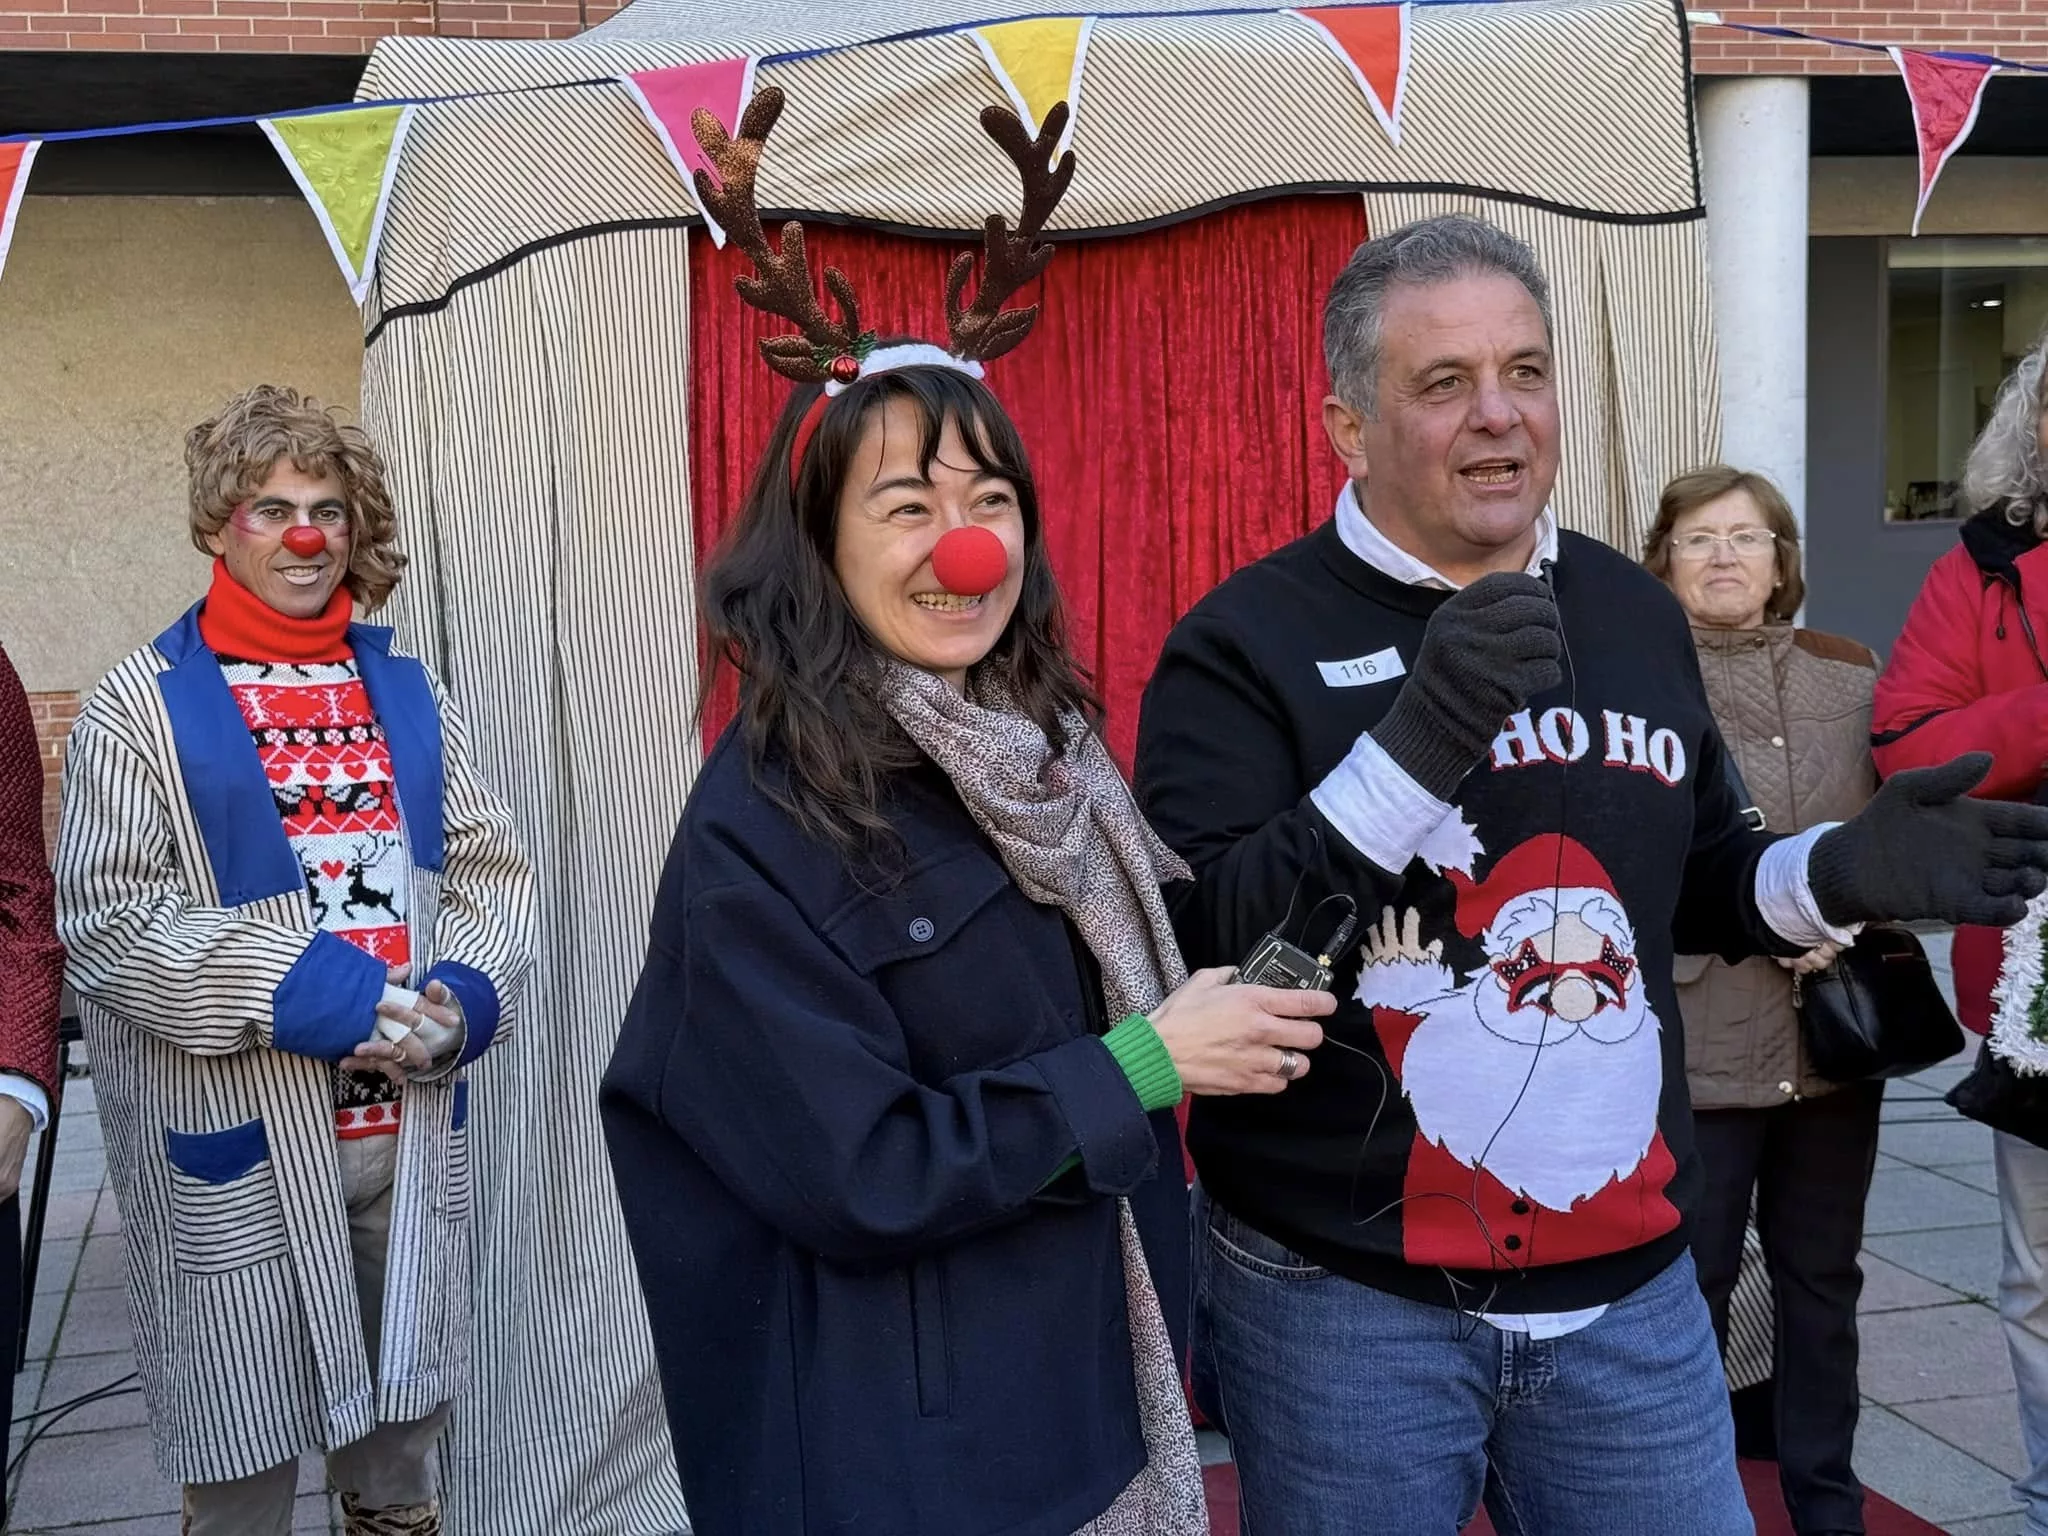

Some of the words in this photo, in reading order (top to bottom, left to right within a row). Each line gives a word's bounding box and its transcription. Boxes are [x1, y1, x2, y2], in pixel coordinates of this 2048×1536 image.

[1340, 659, 1377, 680] 116
[1489, 706, 1590, 772] HO
[1600, 708, 1687, 788] HO
